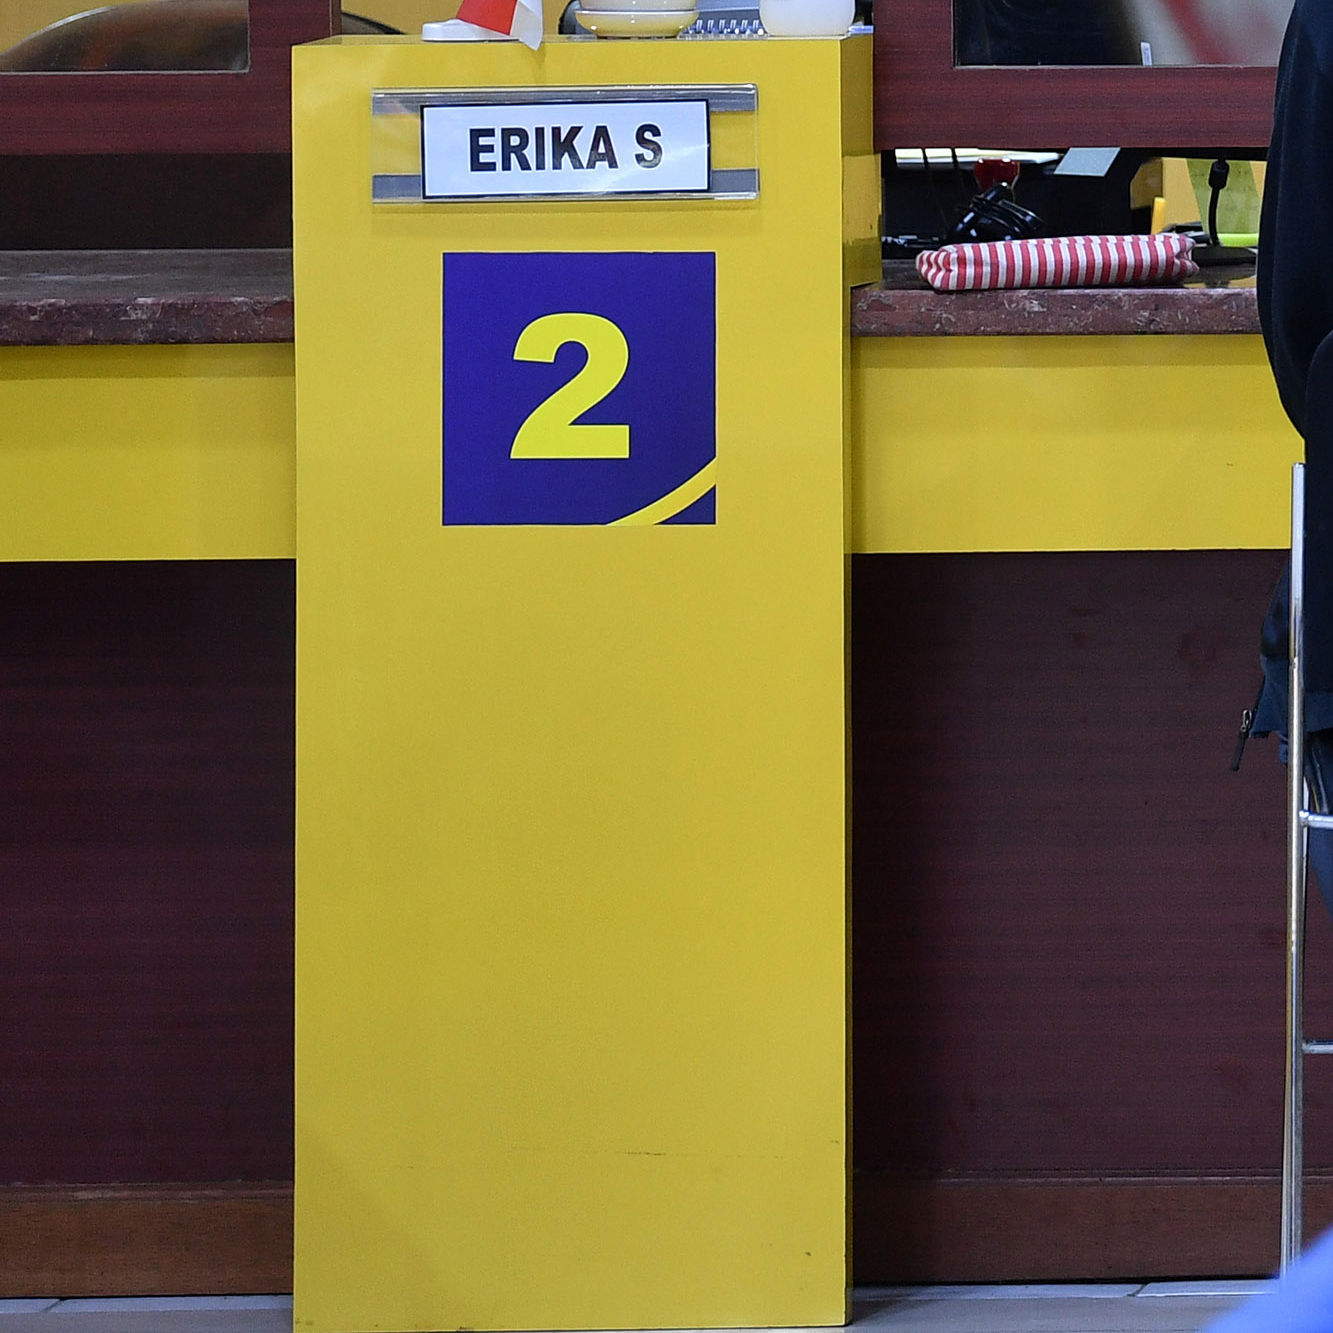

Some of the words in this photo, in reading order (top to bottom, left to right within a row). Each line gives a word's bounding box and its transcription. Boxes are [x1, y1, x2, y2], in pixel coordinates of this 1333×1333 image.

[469, 125, 618, 172] ERIKA
[634, 122, 664, 170] S
[510, 312, 630, 460] 2
